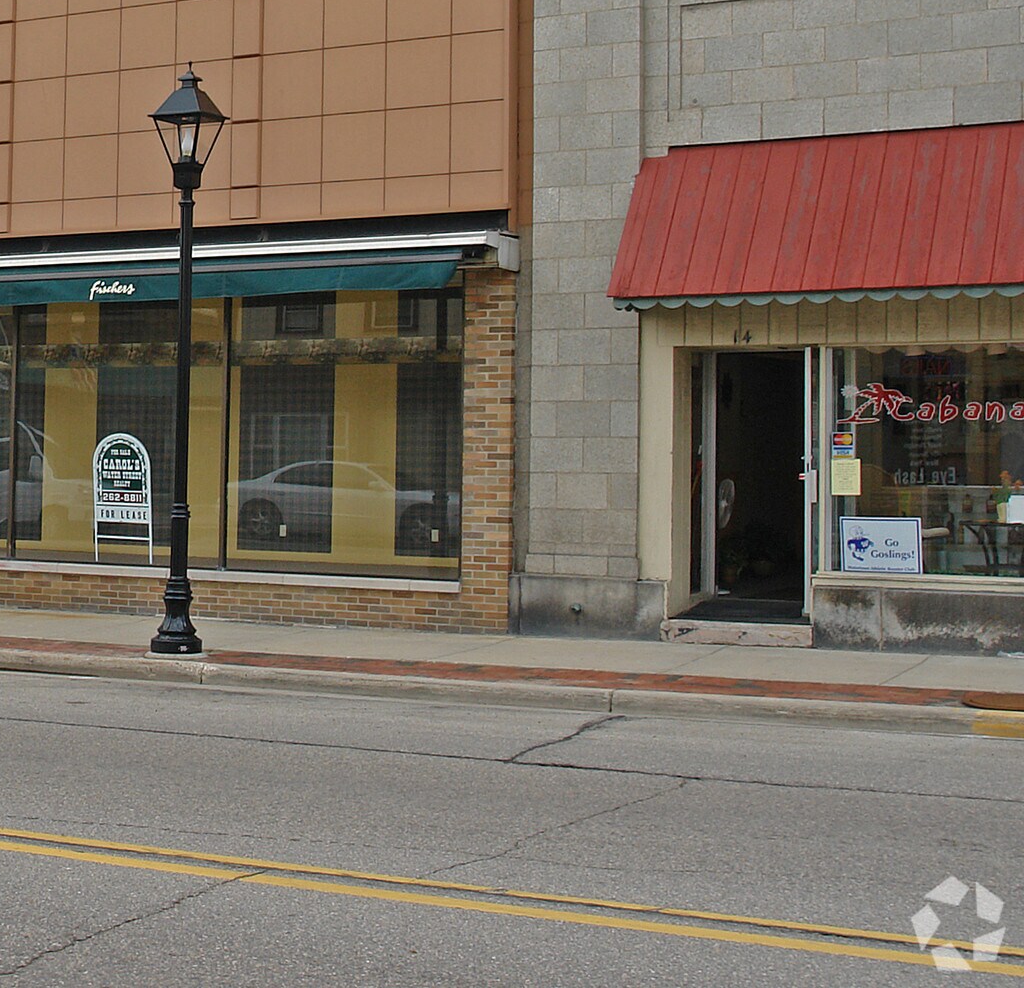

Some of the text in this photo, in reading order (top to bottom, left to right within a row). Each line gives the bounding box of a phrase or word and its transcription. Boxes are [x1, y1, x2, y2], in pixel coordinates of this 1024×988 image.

[103, 458, 141, 471] CAROL'S
[100, 509, 147, 520] FOR LEASE
[884, 538, 899, 547] Go
[870, 549, 915, 561] Goslings!
